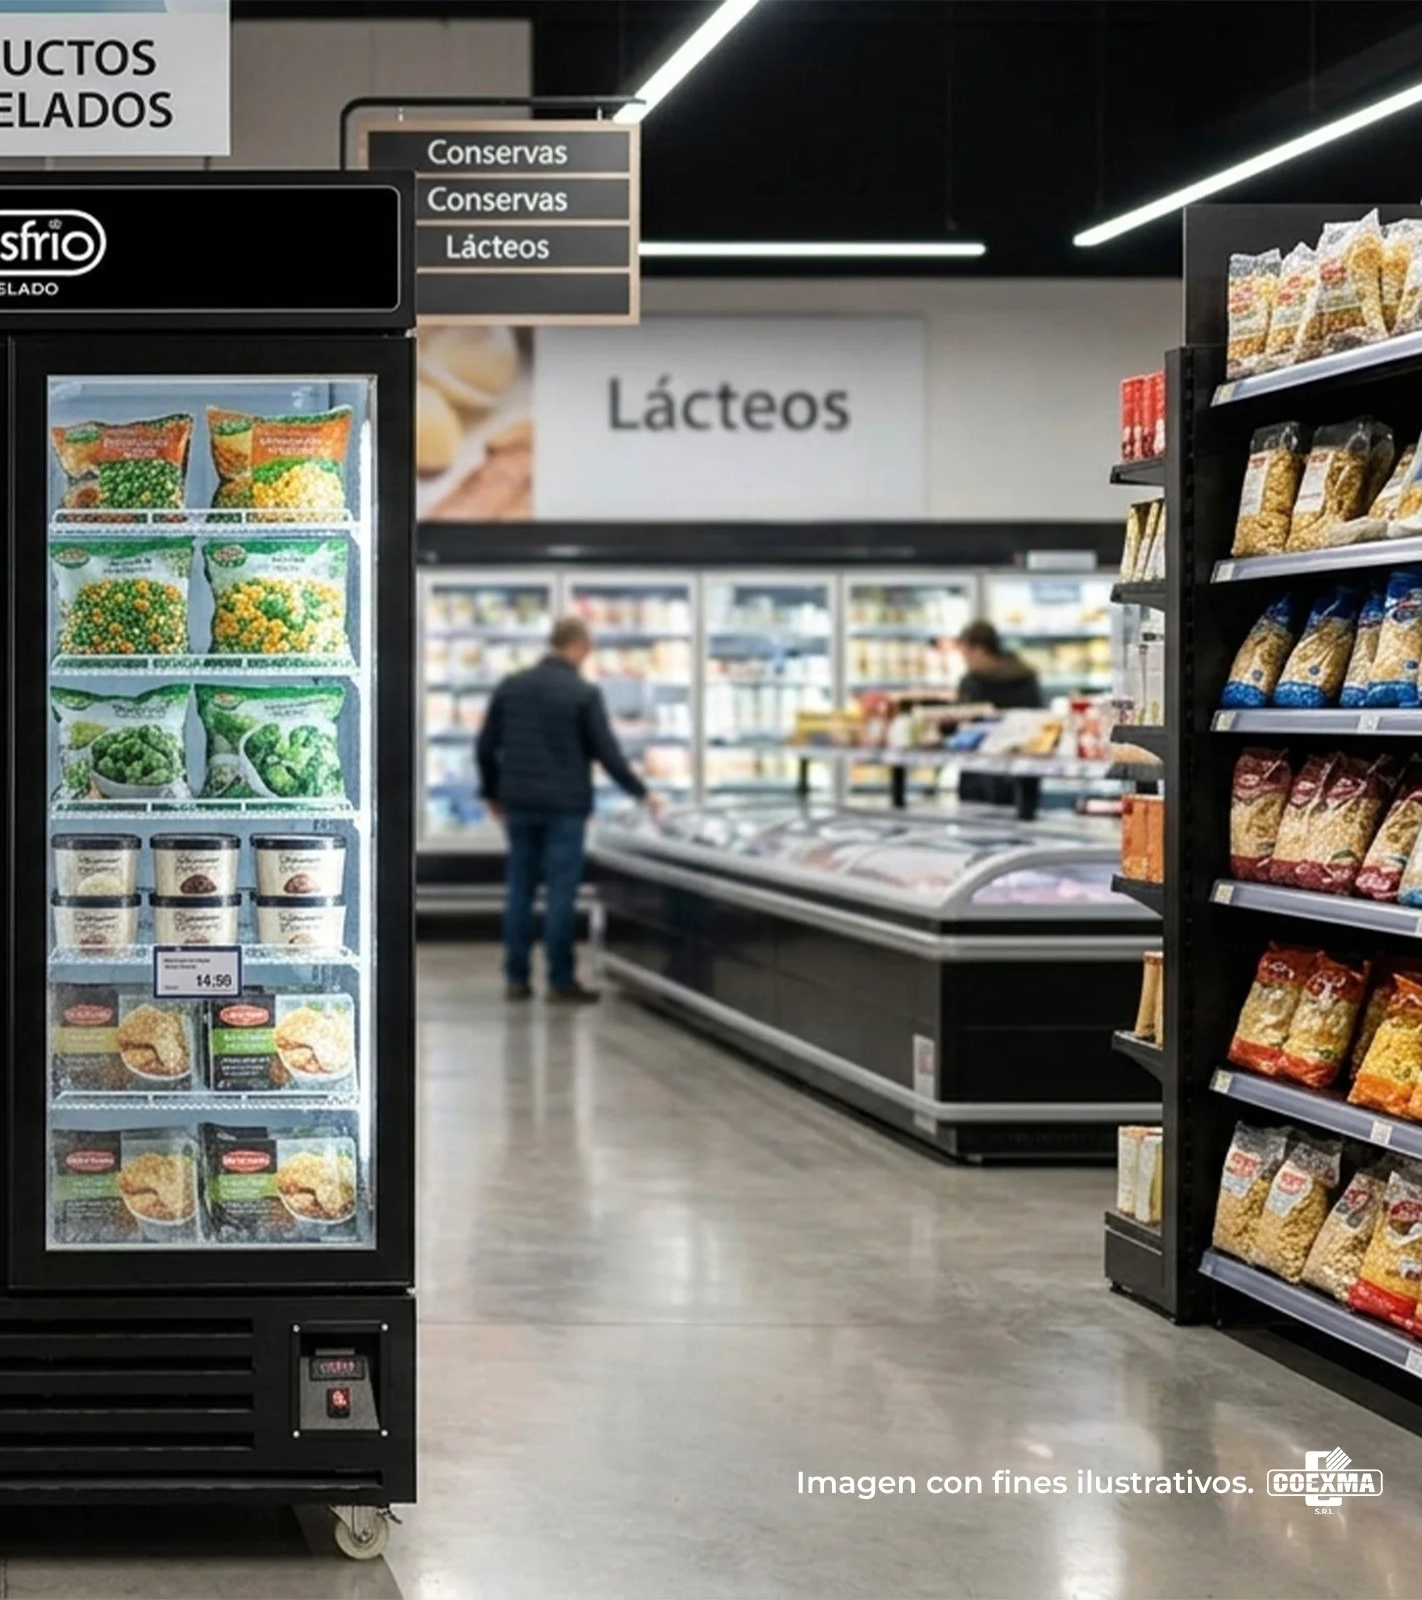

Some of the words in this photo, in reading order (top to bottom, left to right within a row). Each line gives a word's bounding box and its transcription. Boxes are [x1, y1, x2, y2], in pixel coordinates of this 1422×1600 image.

[426, 139, 568, 165] Conservas
[426, 186, 568, 213] Conservas
[446, 233, 550, 260] Lácteos
[607, 373, 851, 433] Lácteos
